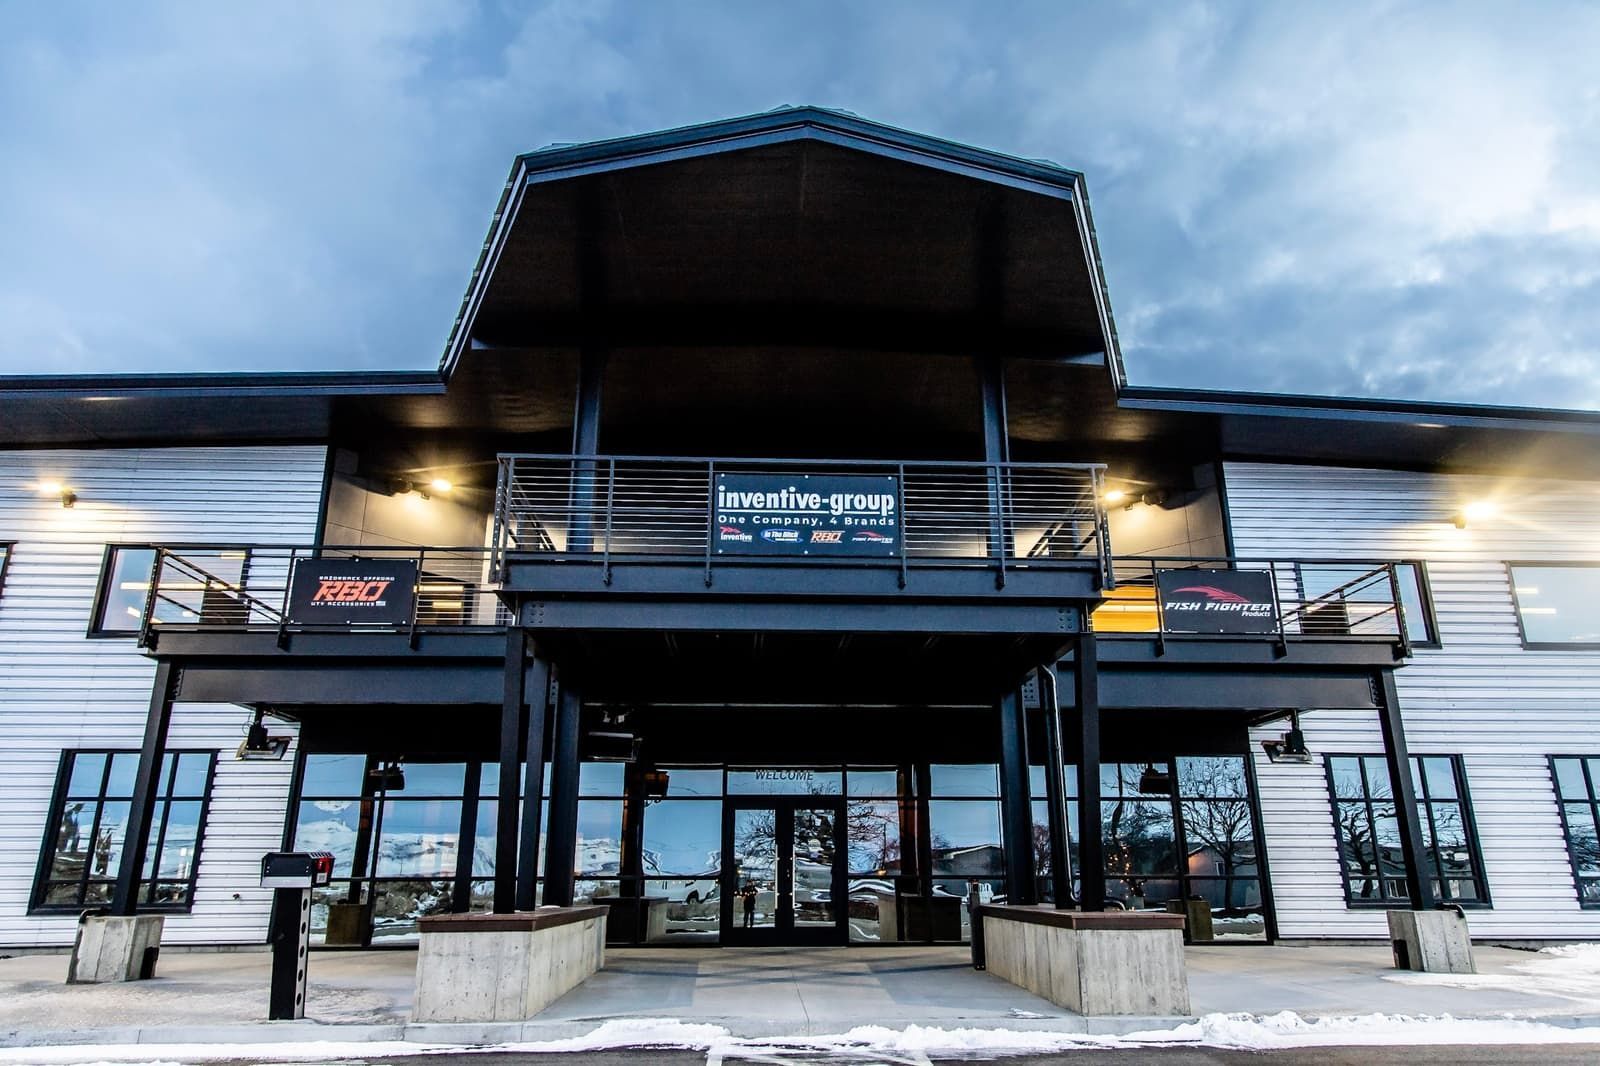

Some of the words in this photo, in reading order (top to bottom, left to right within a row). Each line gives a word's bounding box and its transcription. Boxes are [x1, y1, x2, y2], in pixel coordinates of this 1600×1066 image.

[718, 485, 894, 516] inventive-group
[718, 515, 746, 524] One
[752, 515, 823, 526] Company,
[830, 517, 838, 525] 4
[844, 517, 895, 526] Brands
[811, 532, 842, 542] RBO
[312, 580, 391, 601] RBO
[1165, 602, 1202, 611] FISH
[1204, 603, 1272, 611] FIGHTER
[755, 769, 813, 780] WELCOME
